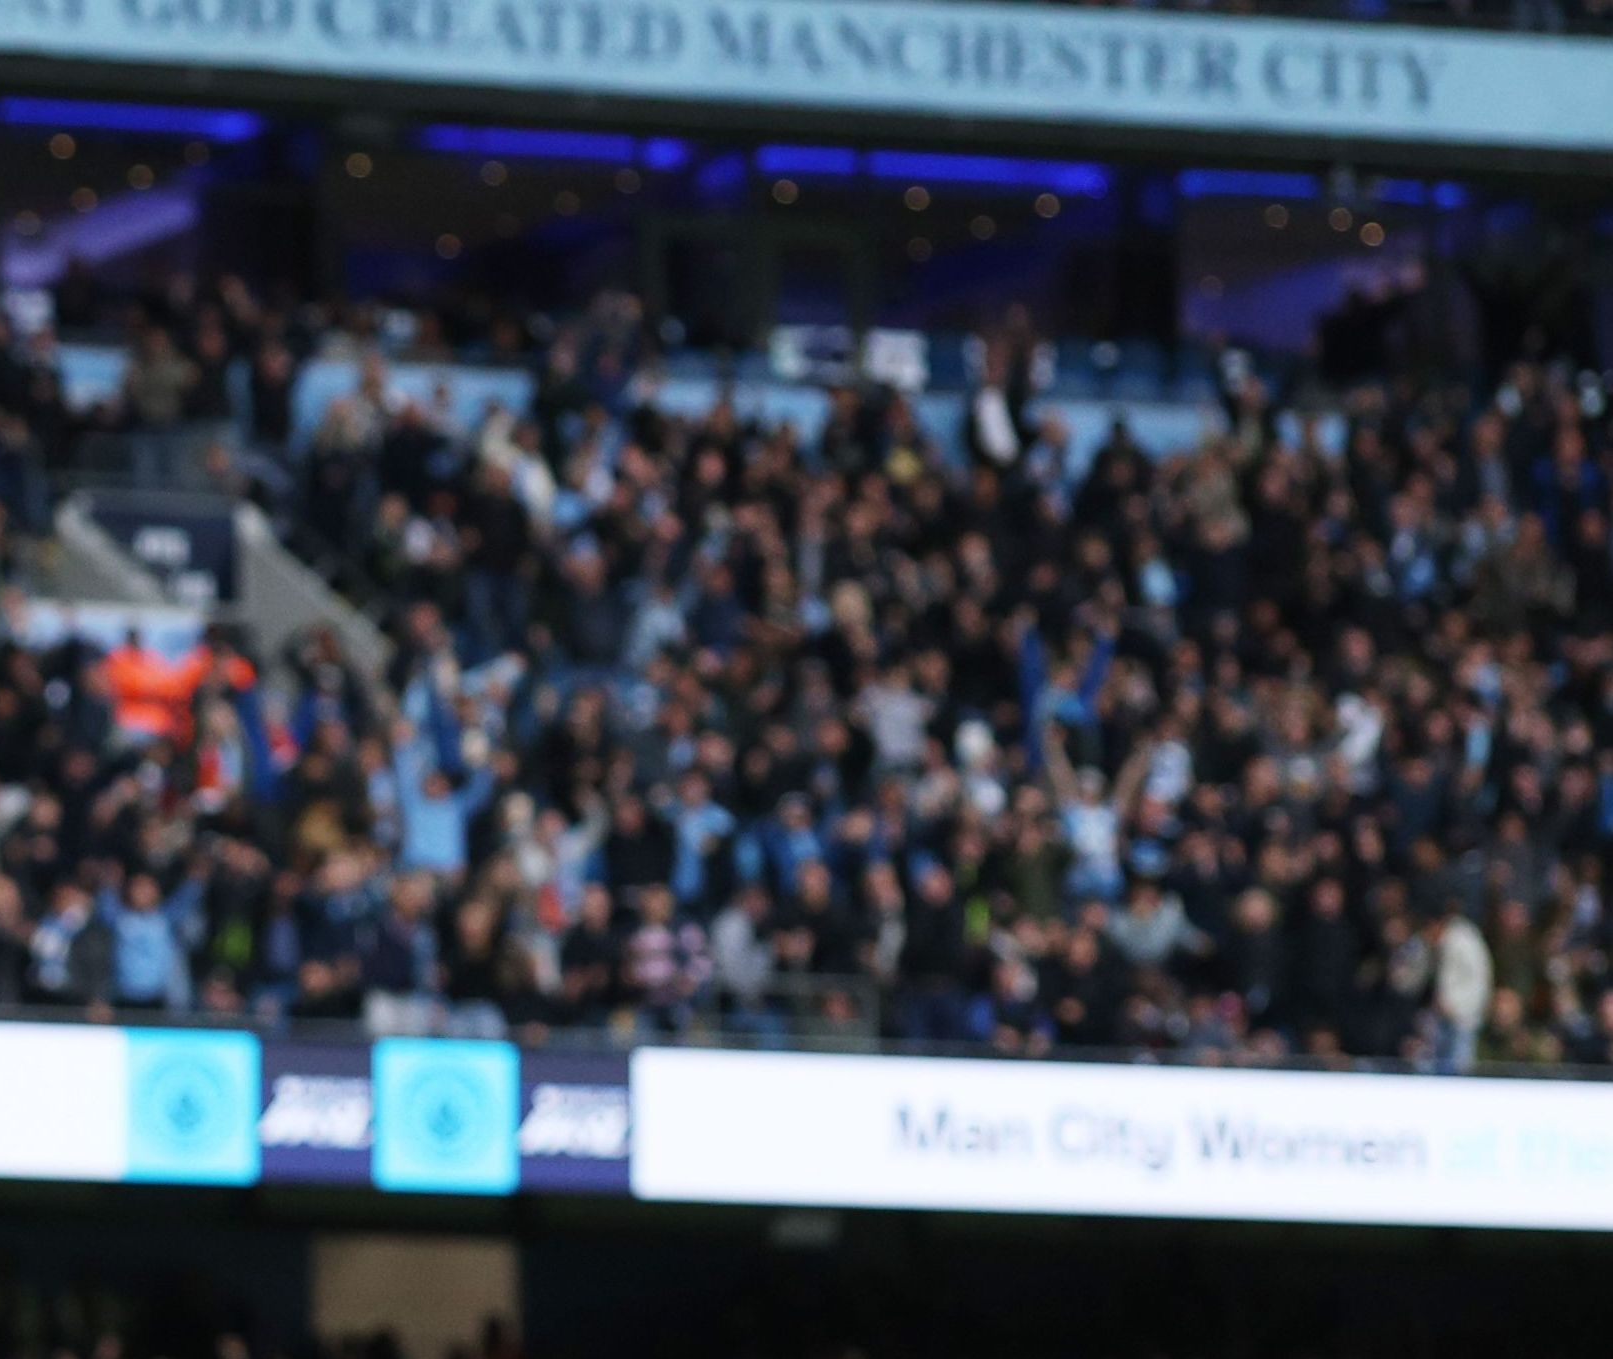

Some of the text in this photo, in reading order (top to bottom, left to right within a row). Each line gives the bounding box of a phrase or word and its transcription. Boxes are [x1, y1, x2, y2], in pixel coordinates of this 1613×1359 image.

[310, 0, 685, 65] CREATED
[703, 8, 1243, 98] MANCHESTER
[1259, 38, 1445, 112] CITY
[895, 1103, 1035, 1157] Man
[1048, 1107, 1171, 1177] City
[1189, 1110, 1429, 1171] Women
